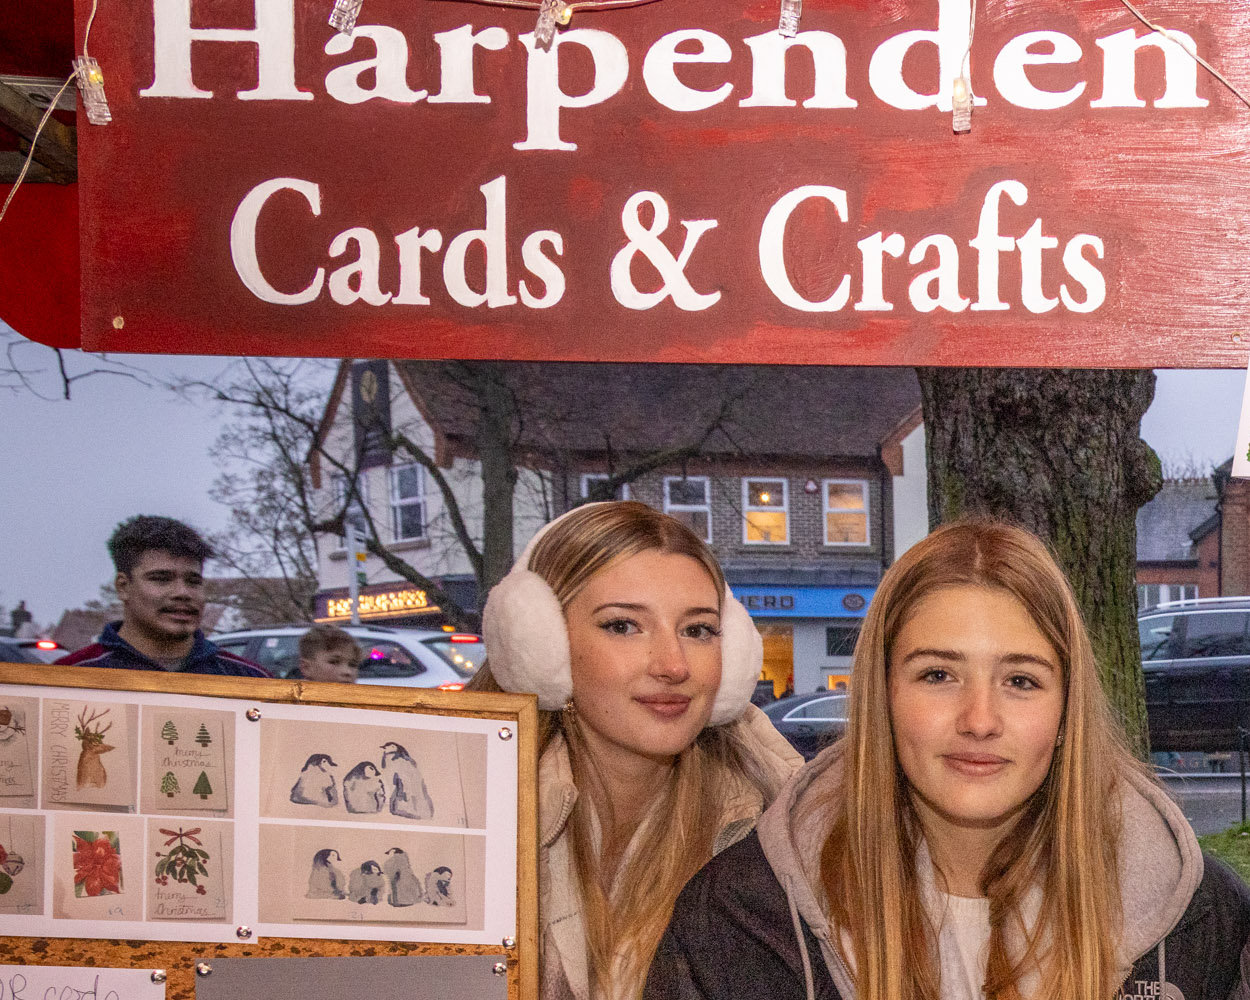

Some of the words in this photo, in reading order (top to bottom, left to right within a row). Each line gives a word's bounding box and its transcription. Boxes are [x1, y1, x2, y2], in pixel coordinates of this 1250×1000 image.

[139, 0, 1209, 150] Harpenden
[230, 175, 565, 308] Cards
[610, 190, 722, 311] &
[758, 179, 1107, 313] Crafts
[741, 594, 794, 610] ERO
[50, 702, 70, 737] MERRY
[1135, 980, 1160, 995] THE
